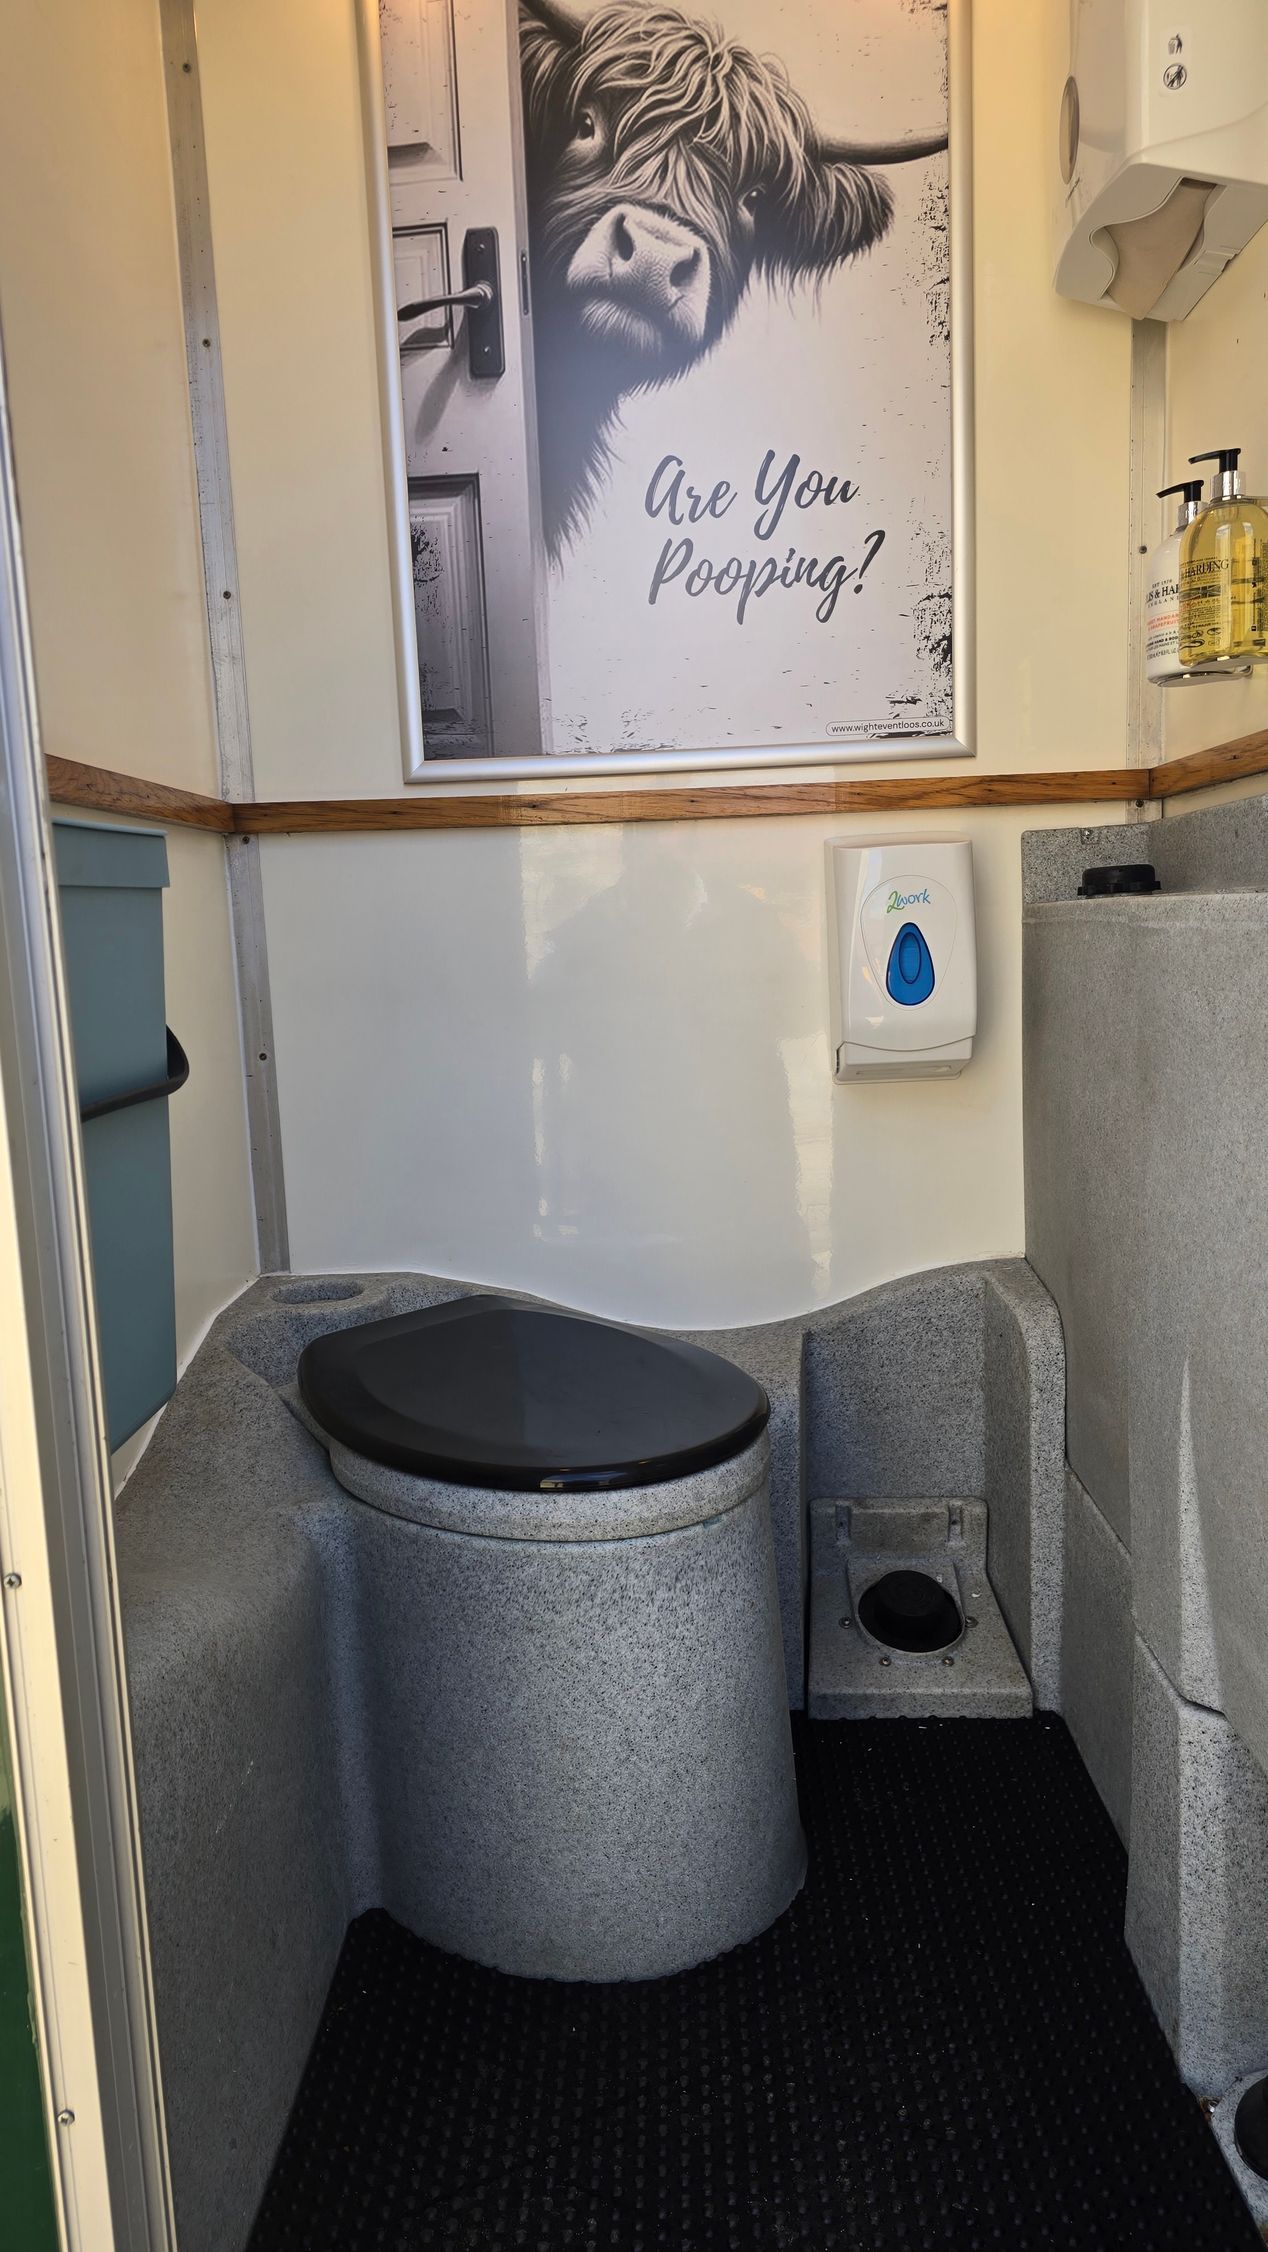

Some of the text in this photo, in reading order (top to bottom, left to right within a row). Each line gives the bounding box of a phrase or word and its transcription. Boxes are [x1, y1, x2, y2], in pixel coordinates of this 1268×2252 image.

[645, 449, 860, 541] Are You
[648, 530, 886, 625] Pooping?
[831, 719, 945, 733] www.wighteventloos.co.uk
[887, 889, 931, 914] 2work
